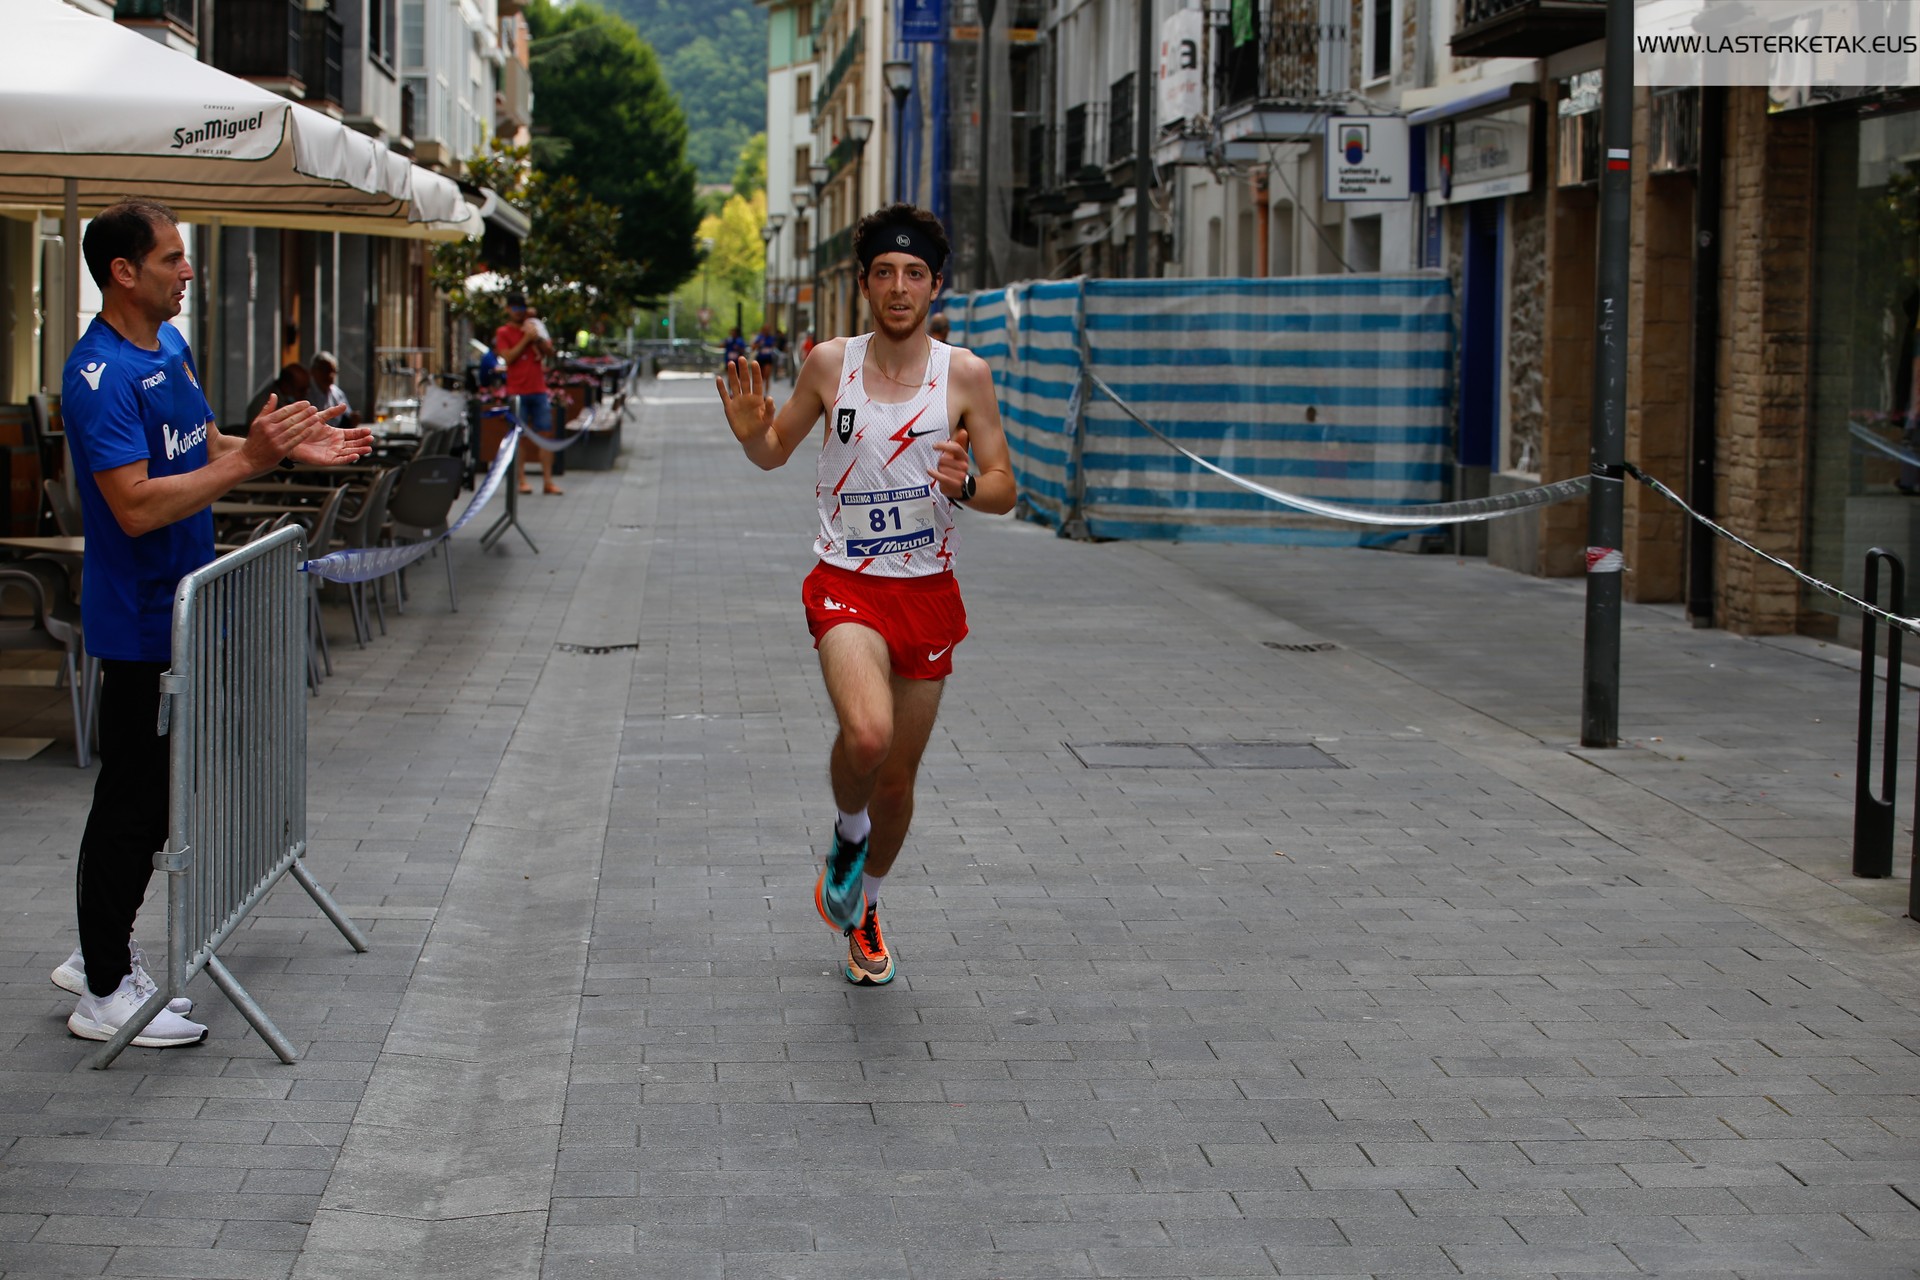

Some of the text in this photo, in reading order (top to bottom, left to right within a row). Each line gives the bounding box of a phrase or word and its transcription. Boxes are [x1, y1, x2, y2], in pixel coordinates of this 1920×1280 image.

[162, 420, 207, 461] Kutxaba
[873, 492, 890, 502] HERRI
[892, 487, 926, 501] LASTERKETA
[868, 506, 902, 533] 81
